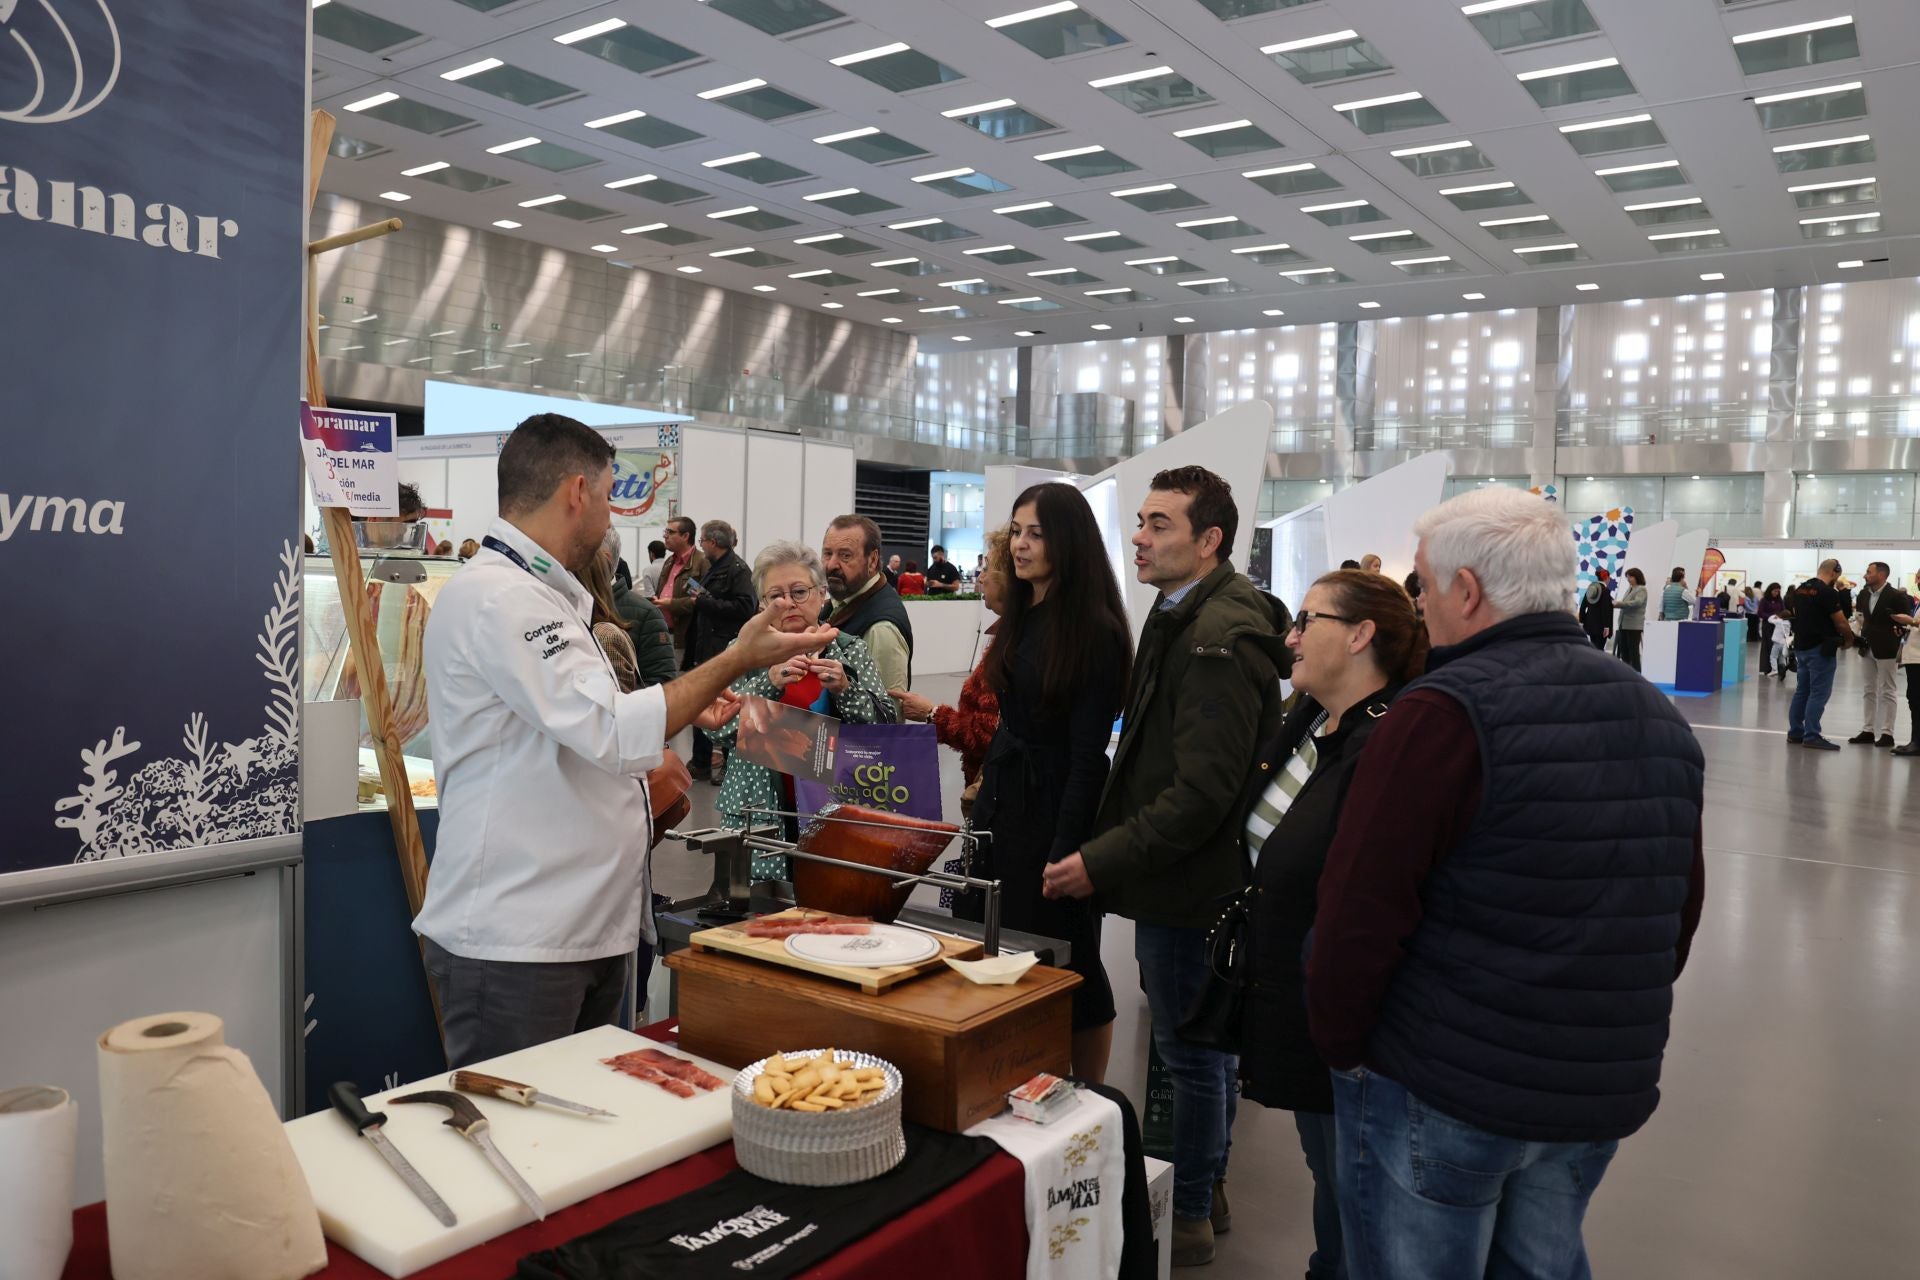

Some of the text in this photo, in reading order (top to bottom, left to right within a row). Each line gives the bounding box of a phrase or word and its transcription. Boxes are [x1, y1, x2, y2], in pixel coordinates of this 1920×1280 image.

[352, 458, 375, 469] MAR
[525, 621, 564, 642] Cortador
[546, 634, 560, 645] de
[542, 638, 570, 660] Jamón
[736, 1211, 791, 1239] MAR
